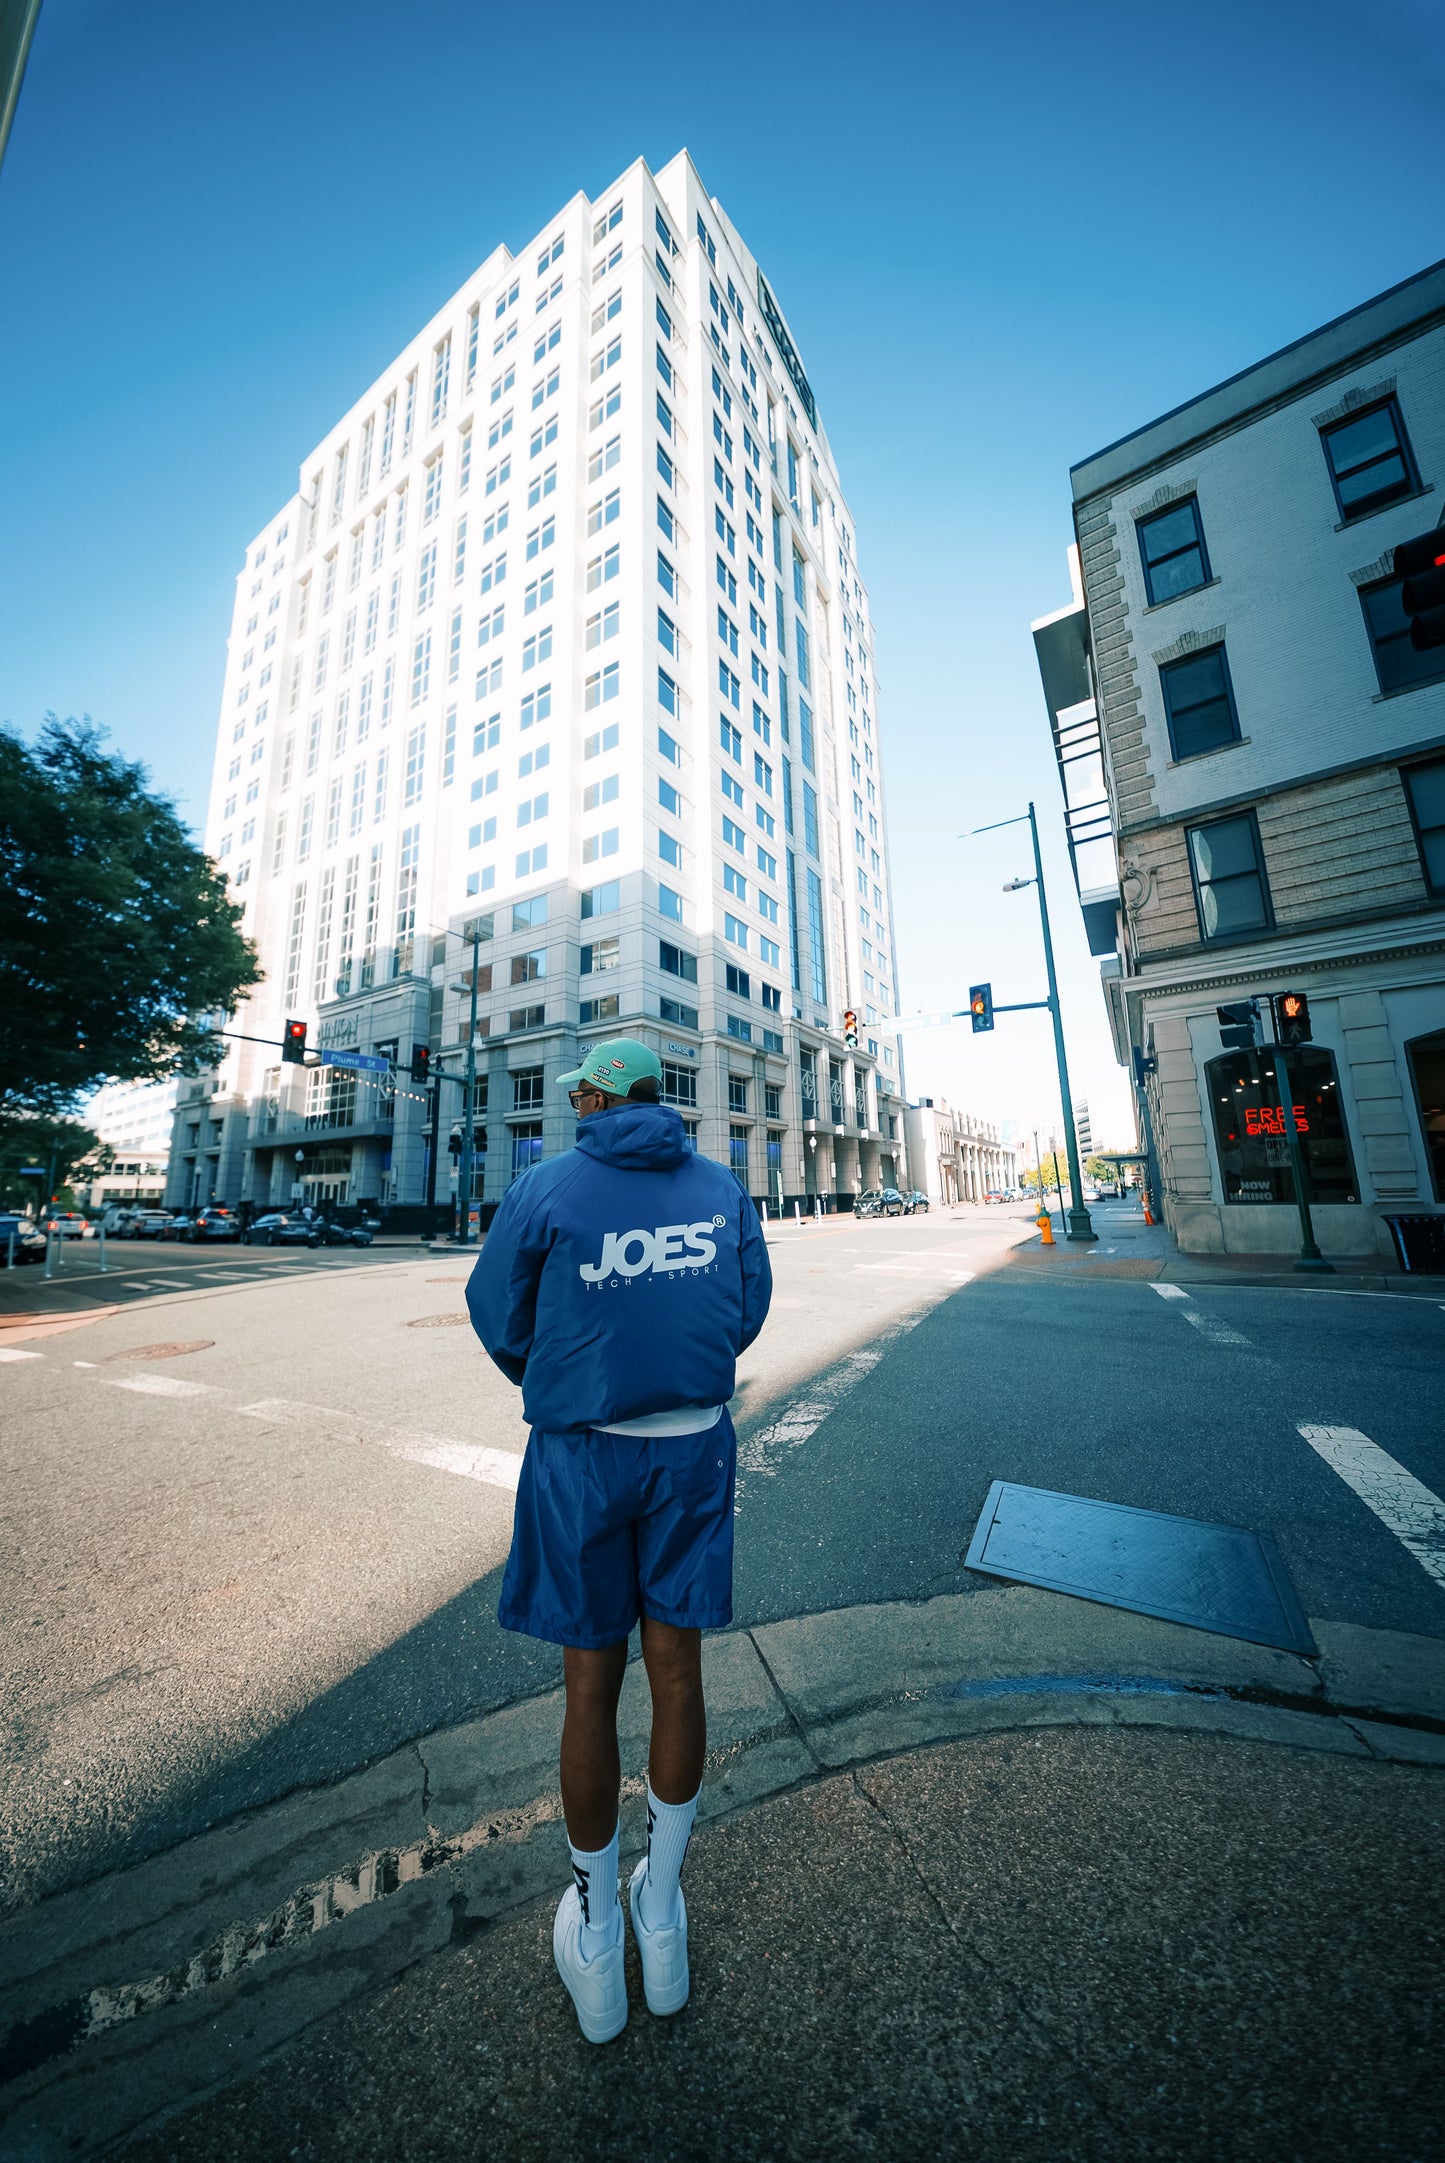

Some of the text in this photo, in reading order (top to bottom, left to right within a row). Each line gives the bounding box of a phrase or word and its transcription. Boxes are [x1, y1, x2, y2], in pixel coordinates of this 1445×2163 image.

[669, 1043, 690, 1057] CHASE
[330, 1053, 376, 1069] Plume St
[1246, 1119, 1309, 1136] SMELS
[1240, 1181, 1270, 1190] NOW
[1229, 1192, 1273, 1201] HIRING
[585, 1264, 719, 1291] TECH SPORT
